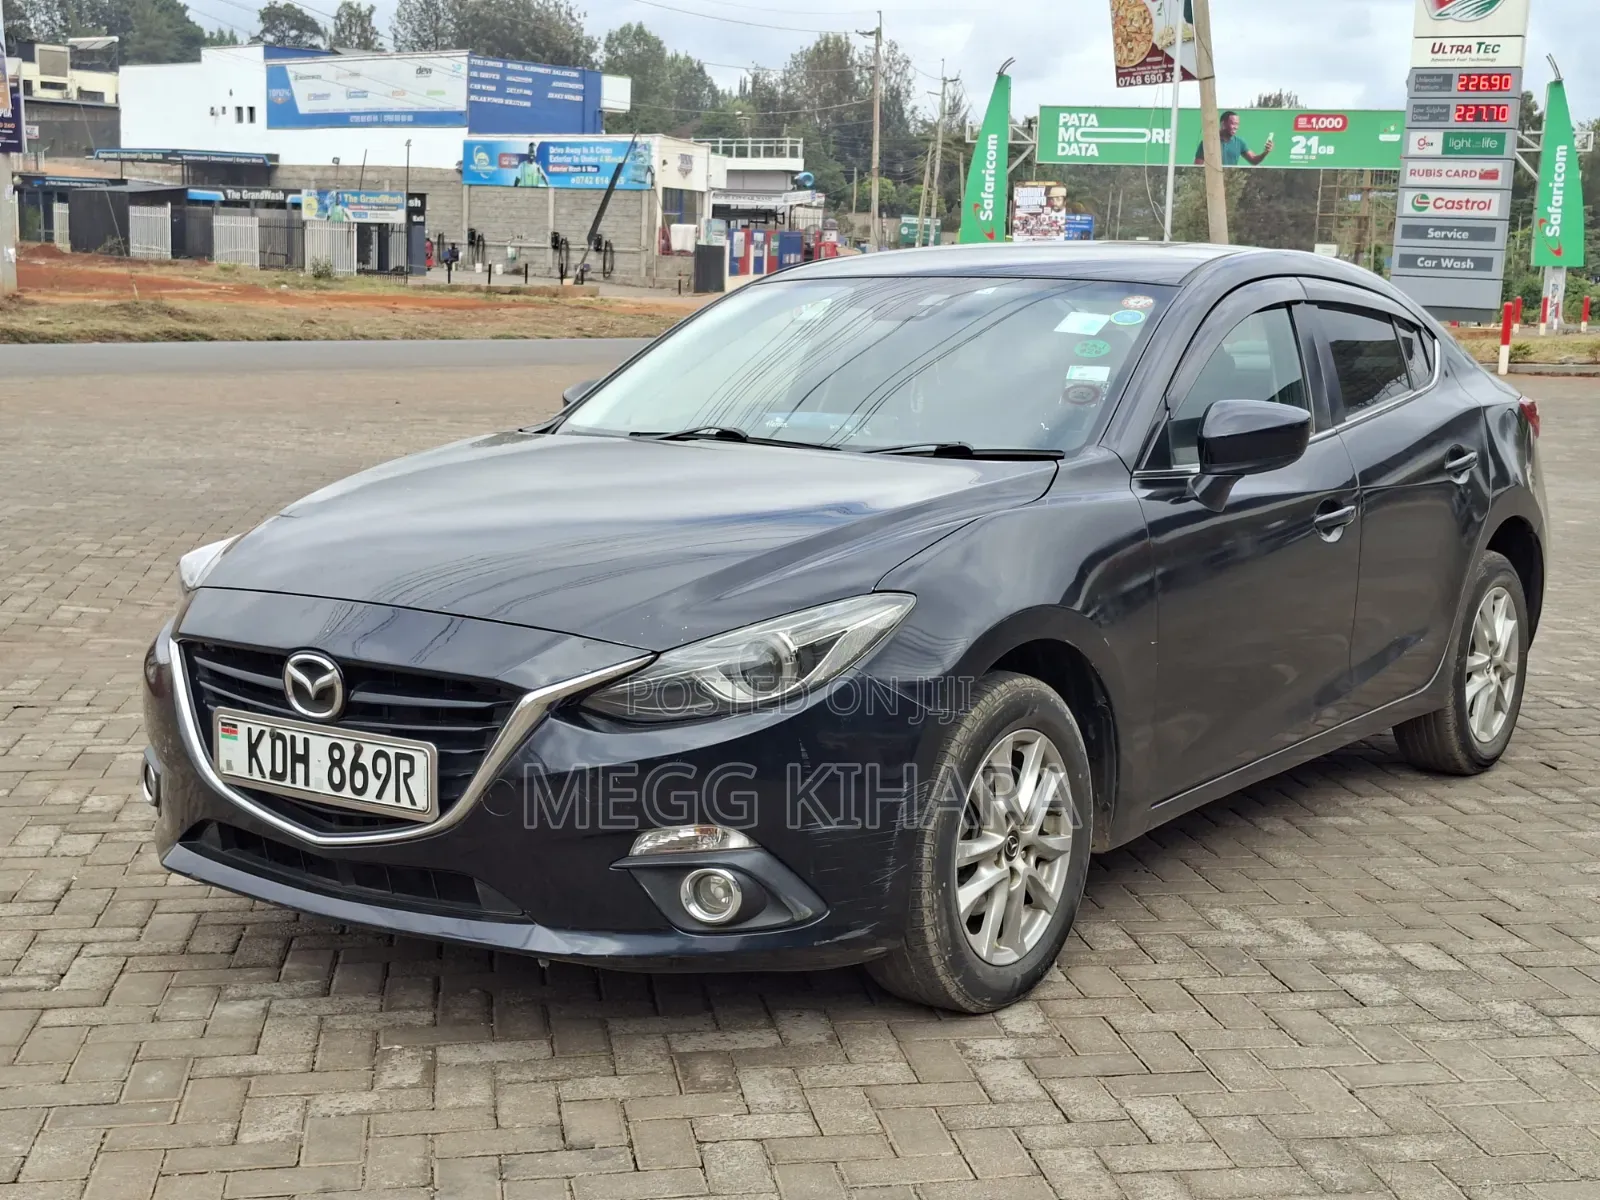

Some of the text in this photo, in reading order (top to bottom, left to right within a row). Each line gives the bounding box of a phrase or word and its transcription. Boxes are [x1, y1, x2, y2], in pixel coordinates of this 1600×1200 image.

[1430, 41, 1501, 54] ULTRA TEC
[1118, 75, 1142, 87] 0748
[1144, 73, 1163, 84] 690
[1457, 74, 1512, 91] 226.90
[1058, 112, 1099, 127] PATA
[1454, 105, 1509, 121] 227.70
[1310, 116, 1343, 130] 1,000
[1057, 142, 1099, 157] DATA
[1448, 137, 1471, 150] light
[1481, 136, 1498, 149] life
[979, 133, 998, 221] Safaricom
[1445, 169, 1477, 179] CARD
[226, 189, 285, 201] The GrandWash
[1545, 144, 1568, 238] Safaricom
[344, 193, 403, 205] The GrandWash
[1432, 197, 1493, 211] Castrol
[1427, 228, 1469, 240] Service
[1416, 257, 1475, 270] Car Wash
[247, 726, 417, 807] KDH 869R
